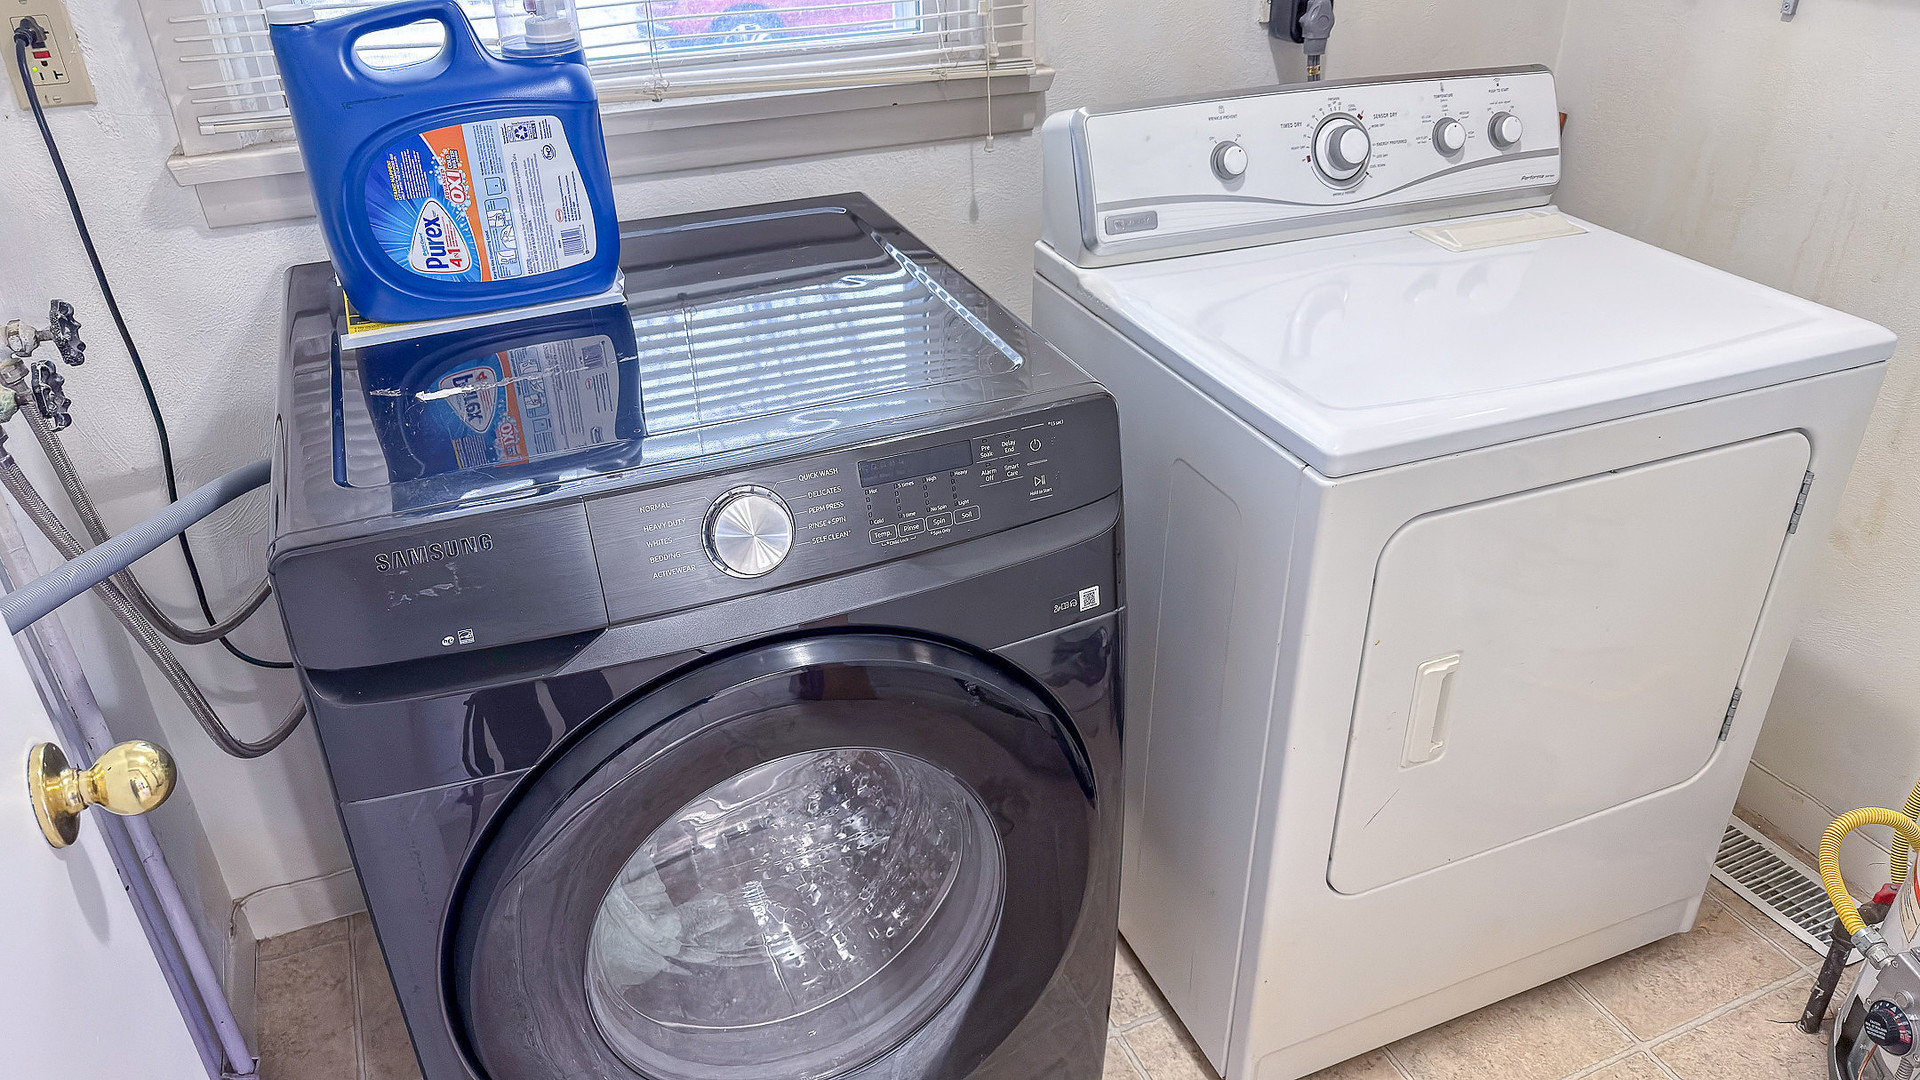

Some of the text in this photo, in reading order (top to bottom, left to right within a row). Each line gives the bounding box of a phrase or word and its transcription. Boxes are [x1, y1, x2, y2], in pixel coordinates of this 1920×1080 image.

[440, 169, 450, 199] ADVANCED
[446, 170, 466, 204] OXI
[423, 217, 449, 269] Purex
[799, 468, 838, 481] QUICK WASH
[808, 486, 842, 498] DELICATES
[639, 502, 670, 513] NORMAL
[809, 501, 844, 514] PERM PRESS
[643, 518, 686, 532] HEAVY DUTY
[808, 520, 827, 530] RINSE
[831, 516, 846, 524] SPIN
[904, 524, 920, 532] Rinse
[933, 517, 946, 526] Spin
[812, 535, 827, 544] SELF
[874, 531, 892, 539] Temp.
[646, 537, 672, 548] WHITES
[375, 533, 493, 572] SAMSUNG
[650, 552, 680, 563] BEDDING
[653, 564, 696, 579] ACTIVEWEAR
